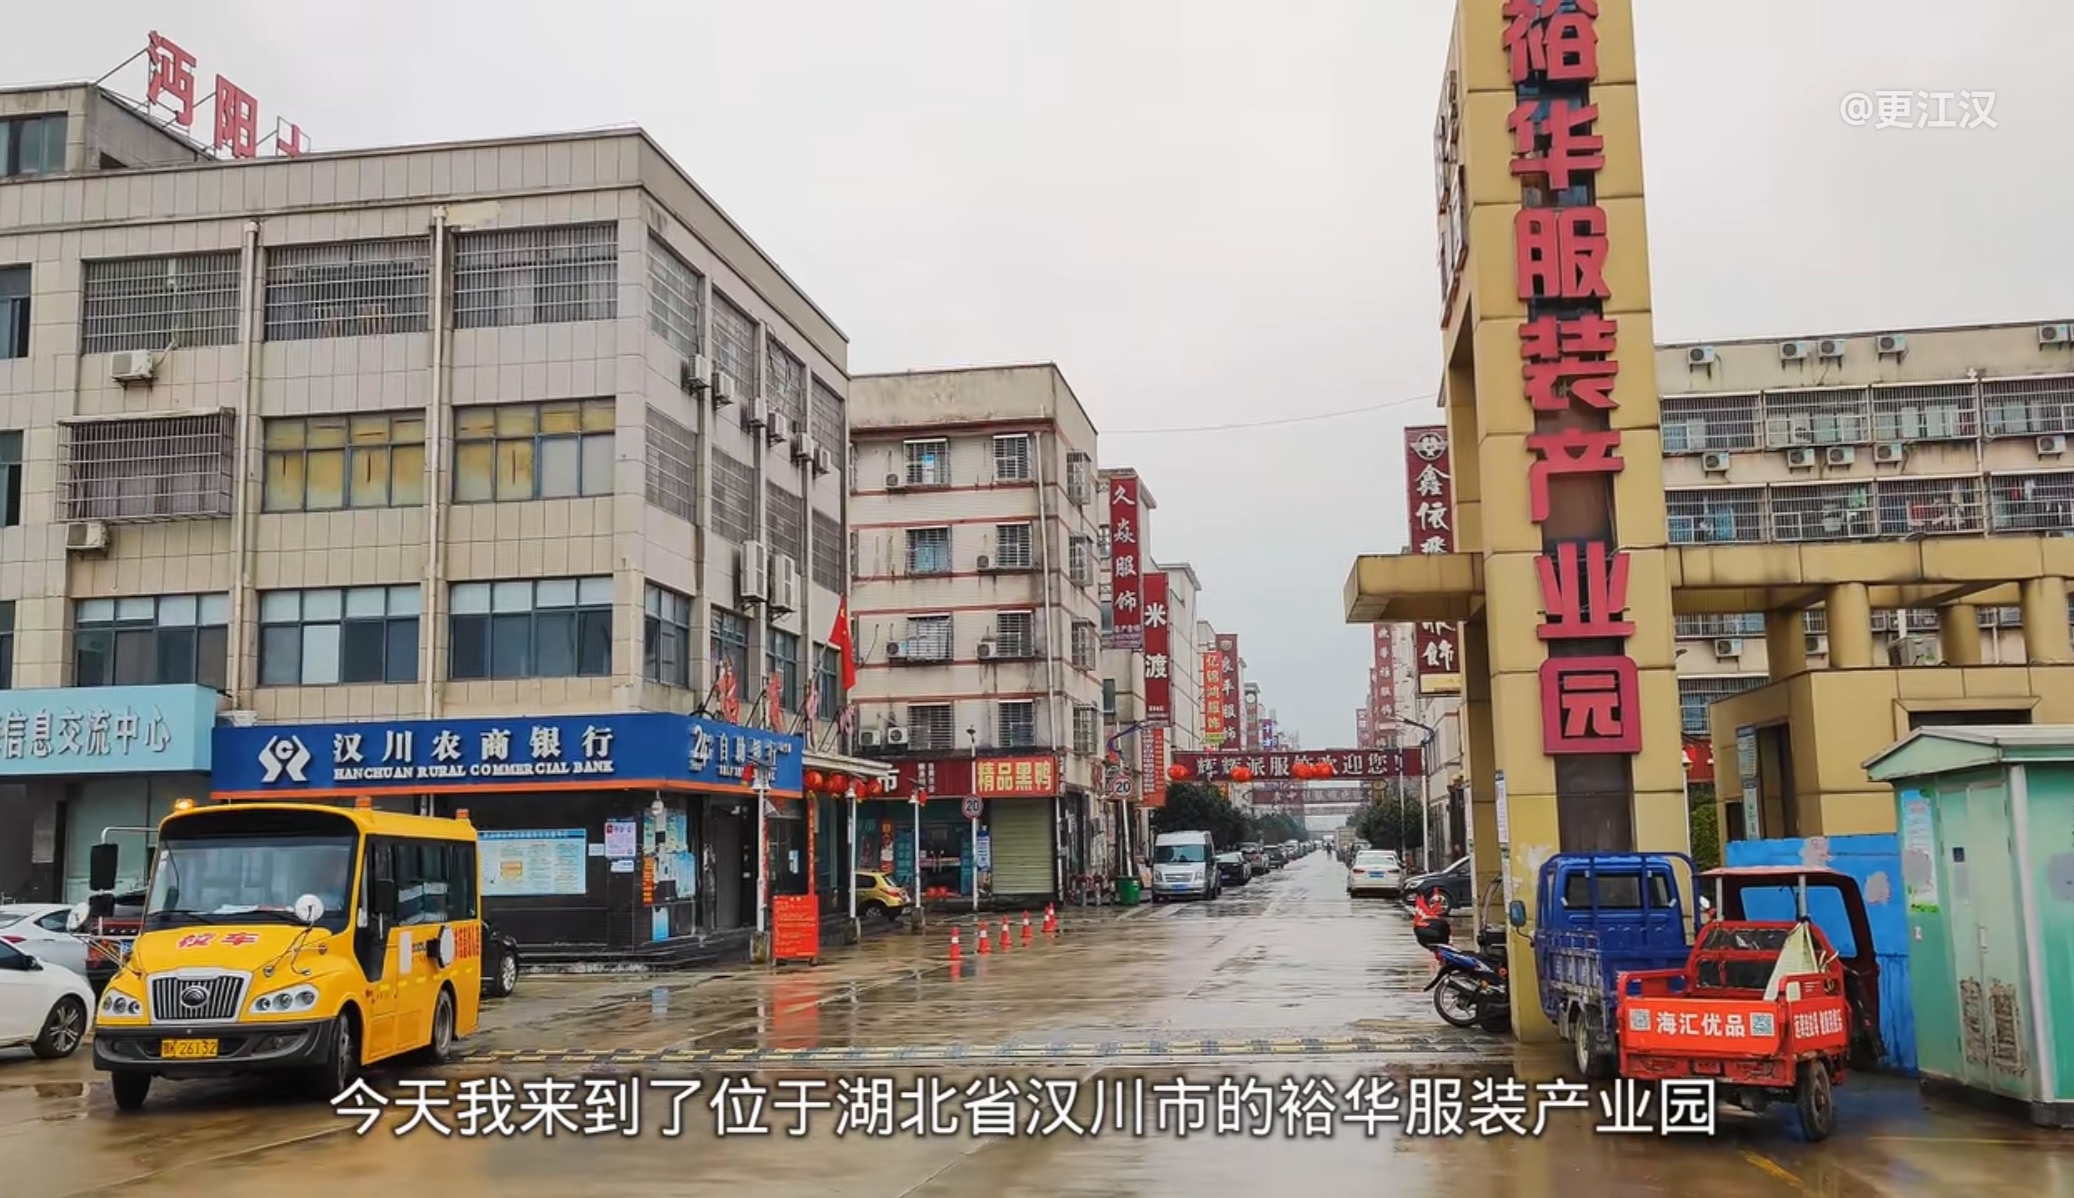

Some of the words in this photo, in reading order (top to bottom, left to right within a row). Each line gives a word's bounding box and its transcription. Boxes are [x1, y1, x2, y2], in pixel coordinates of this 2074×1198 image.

[1502, 0, 1643, 756] 裕华服装产业园
[1144, 602, 1168, 679] 米渡
[0, 705, 172, 760] 信息交流中心
[333, 725, 614, 764] 汉川农商银行
[333, 766, 414, 780] HANCHUAN
[417, 764, 466, 778] RURAL
[470, 761, 570, 777] COMMERCIAL
[573, 760, 615, 774] BANK
[977, 760, 1052, 792] 精品黑鸭
[1116, 781, 1131, 793] 20
[966, 800, 980, 812] 20
[1656, 1011, 1746, 1038] 海汇优品
